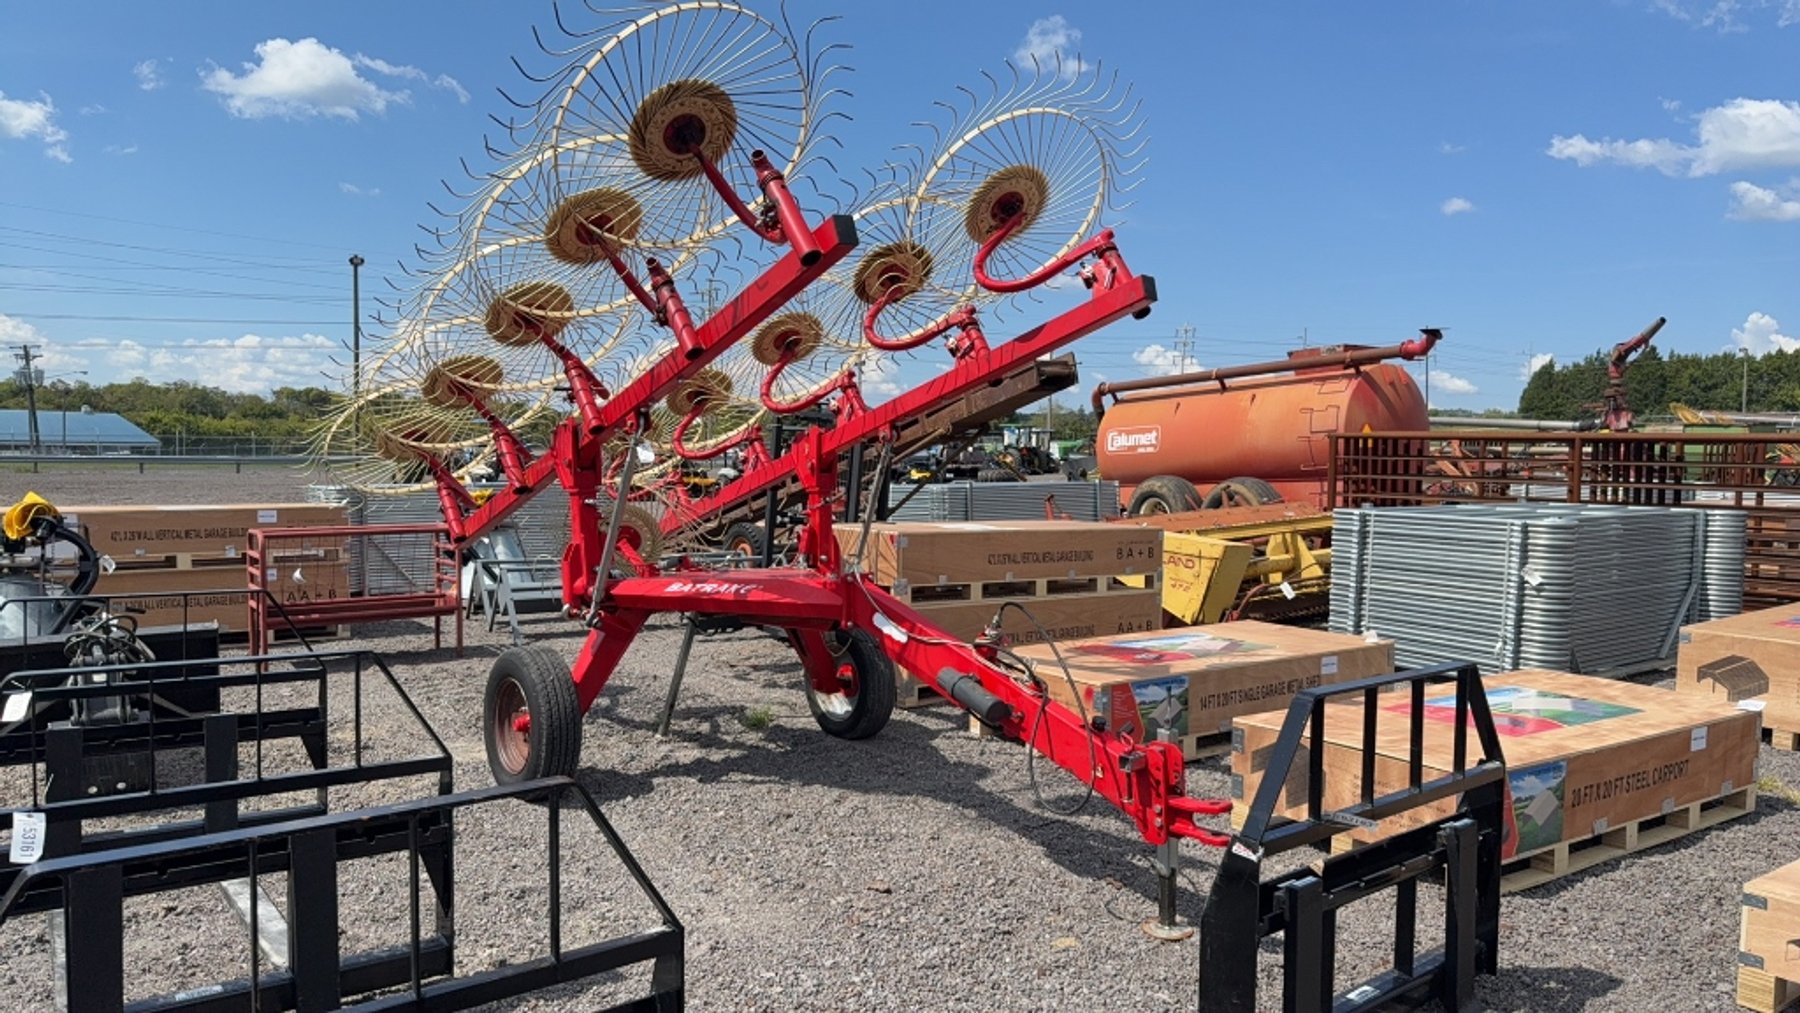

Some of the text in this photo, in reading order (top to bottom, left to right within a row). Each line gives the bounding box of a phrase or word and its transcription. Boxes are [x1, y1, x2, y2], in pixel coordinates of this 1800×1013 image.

[1108, 430, 1157, 451] Calumet
[155, 529, 184, 541] VERTICAL
[184, 529, 203, 540] METAL
[204, 528, 227, 539] GARAGE
[186, 597, 203, 608] ETAL
[1238, 686, 1260, 704] SINGLE
[1261, 681, 1286, 699] GARAGE
[1287, 678, 1304, 694] METAL
[1571, 788, 1581, 808] 20
[1583, 784, 1594, 804] FT
[1602, 779, 1612, 799] 20
[1614, 776, 1624, 796] FT
[1625, 770, 1651, 793] STEEL
[1652, 759, 1690, 786] CARPORT
[19, 826, 37, 858] 53161
